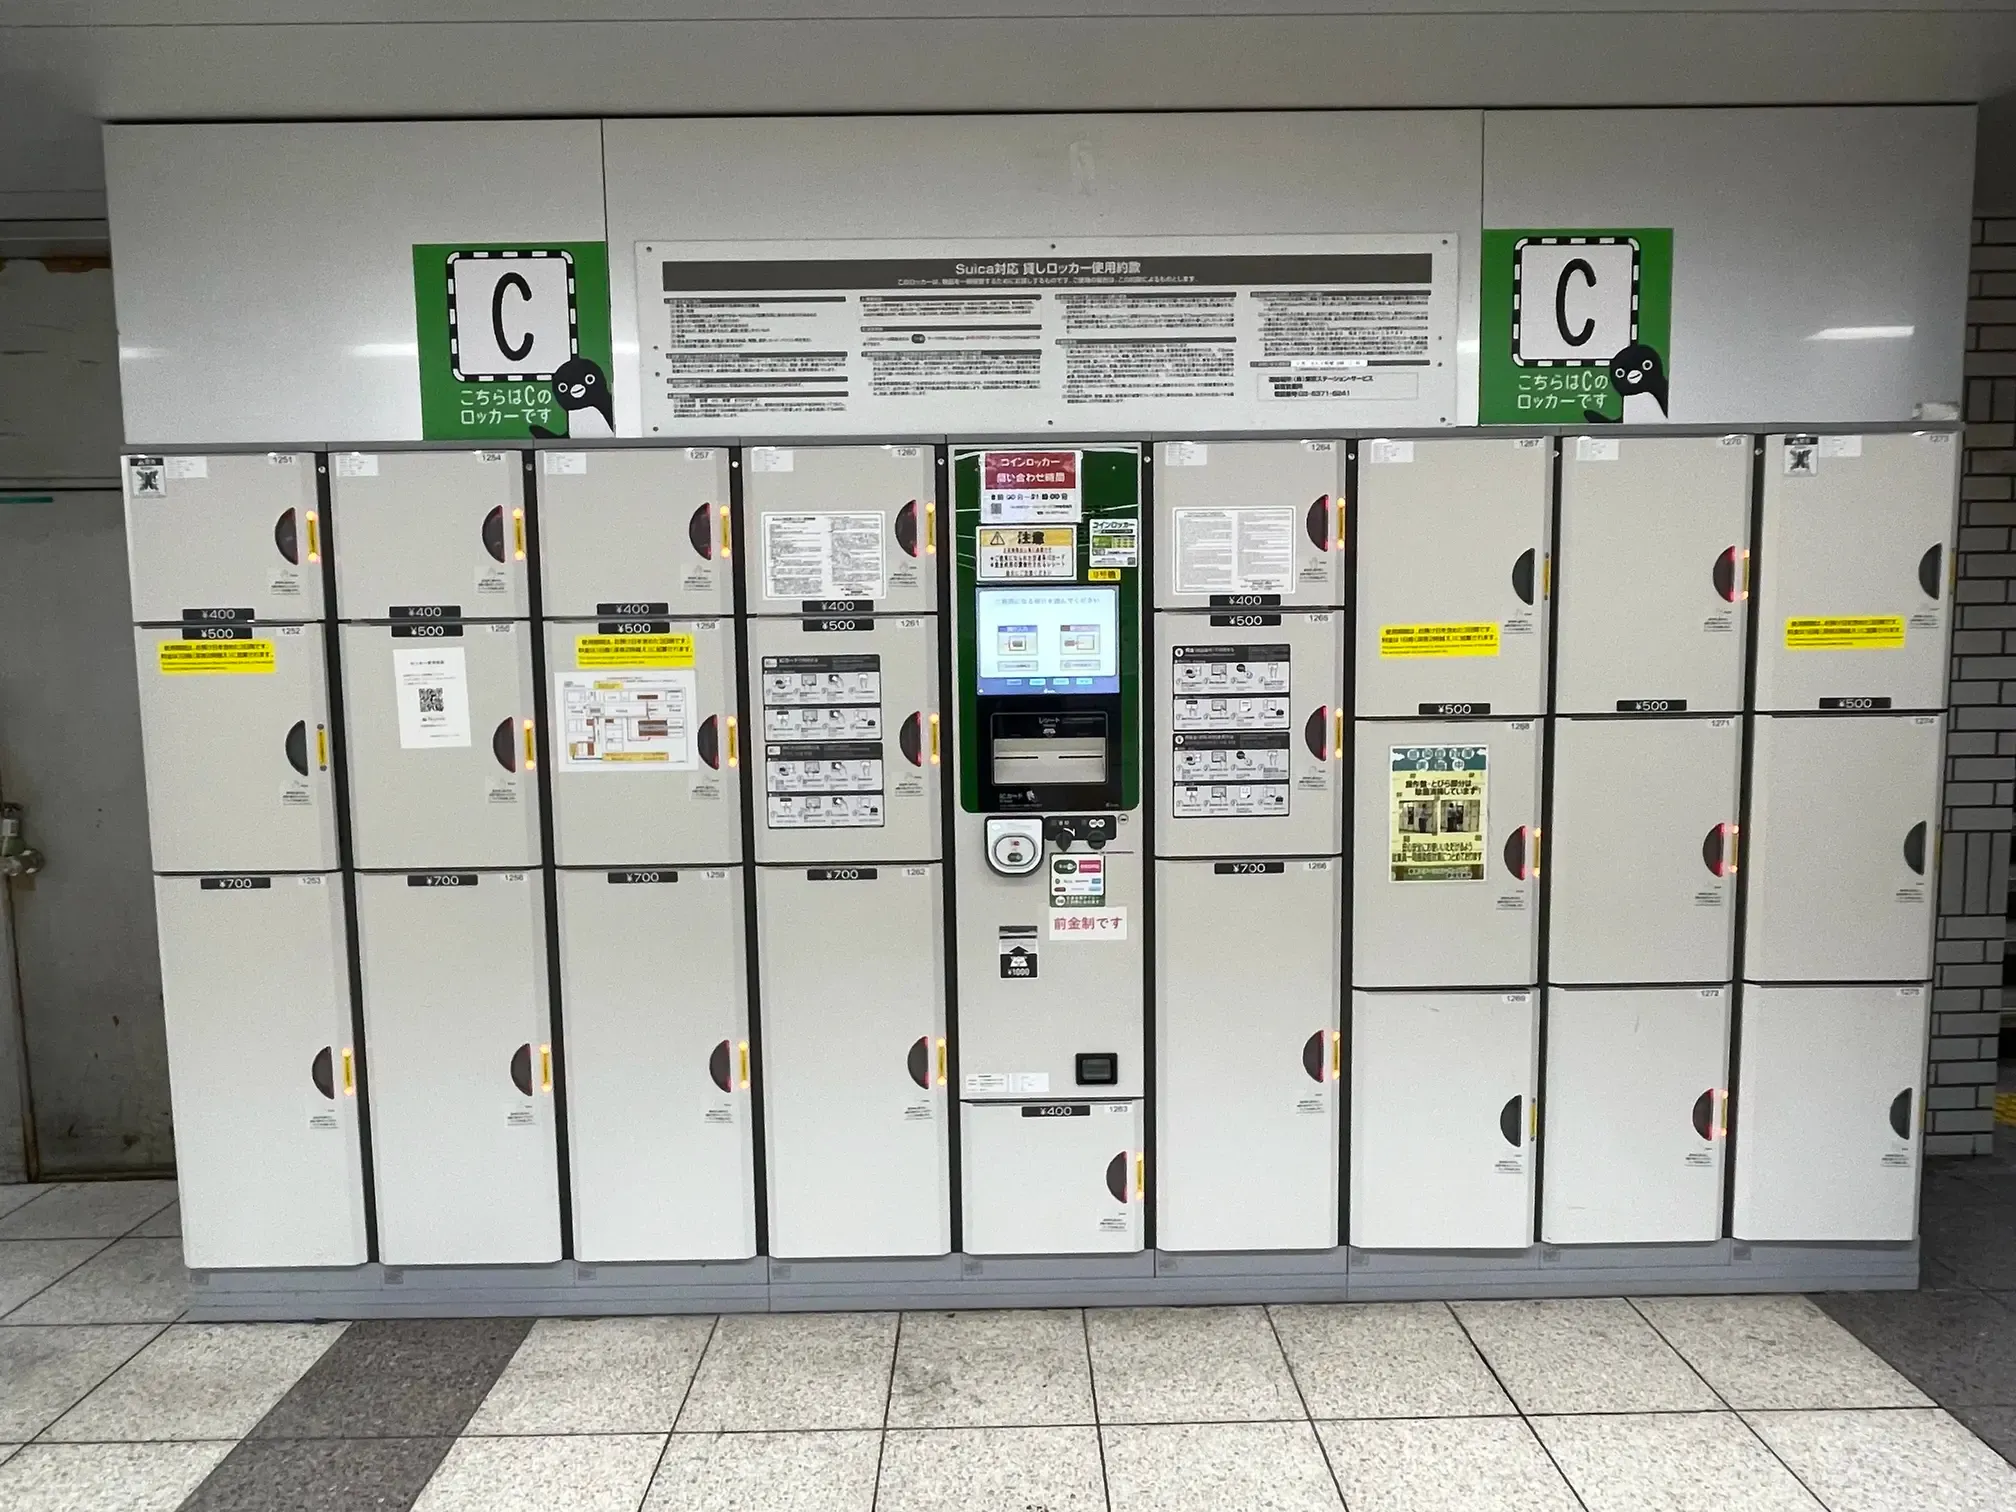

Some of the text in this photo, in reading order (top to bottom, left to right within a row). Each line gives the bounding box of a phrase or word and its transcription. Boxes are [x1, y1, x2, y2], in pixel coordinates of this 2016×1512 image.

[1555, 258, 1597, 347] C
[492, 272, 535, 361] C
[1518, 371, 1609, 391] こちらはCの
[460, 385, 552, 406] こちらはCの
[1517, 394, 1608, 409] ロッカーです
[460, 409, 552, 425] ロッカーです
[1000, 457, 1060, 467] コインロッカー
[996, 472, 1065, 483] 問い合わせ時間
[1017, 531, 1045, 545] 注意
[1228, 596, 1262, 605] ¥400
[616, 605, 650, 614] ¥400
[822, 602, 855, 611] ¥400
[202, 610, 236, 619] ¥400
[408, 607, 442, 617] ¥400
[822, 620, 855, 630] ¥500
[1229, 616, 1263, 626] ¥500
[411, 626, 444, 636] ¥500
[617, 623, 651, 633] ¥500
[201, 629, 234, 639] ¥500
[1635, 701, 1669, 710] ¥500
[1839, 699, 1872, 708] ¥500
[1438, 704, 1472, 714] ¥500
[1232, 863, 1266, 873] ¥700
[627, 872, 659, 882] ¥700
[826, 869, 859, 879] ¥700
[219, 879, 252, 888] ¥700
[426, 876, 459, 885] ¥700
[1054, 917, 1123, 931] 前金制です
[1040, 1106, 1072, 1116] ¥400
